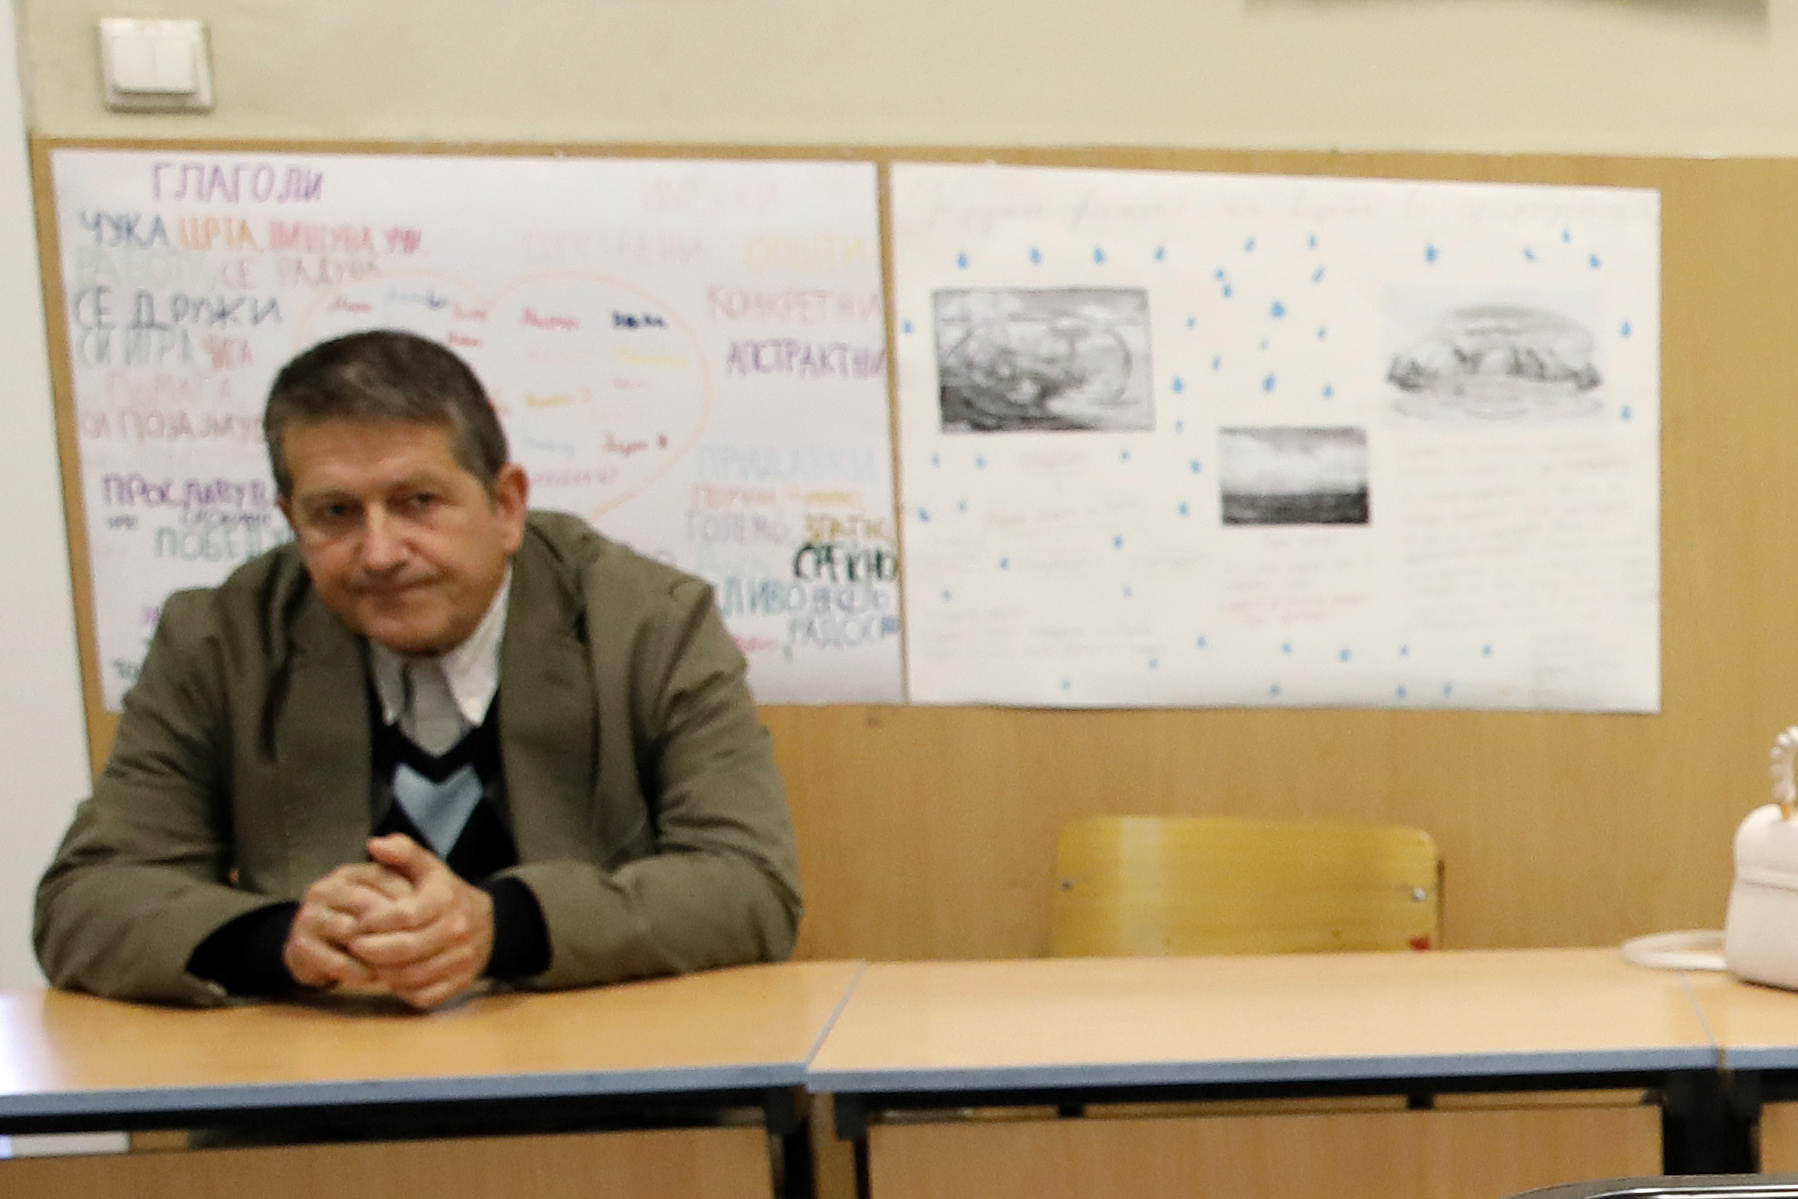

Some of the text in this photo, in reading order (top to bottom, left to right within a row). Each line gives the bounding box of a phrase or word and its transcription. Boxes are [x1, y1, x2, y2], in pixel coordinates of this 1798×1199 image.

[151, 162, 324, 204] ГЛАГОЛИ
[78, 208, 170, 249] ЧУКА
[74, 285, 116, 328] СЕ
